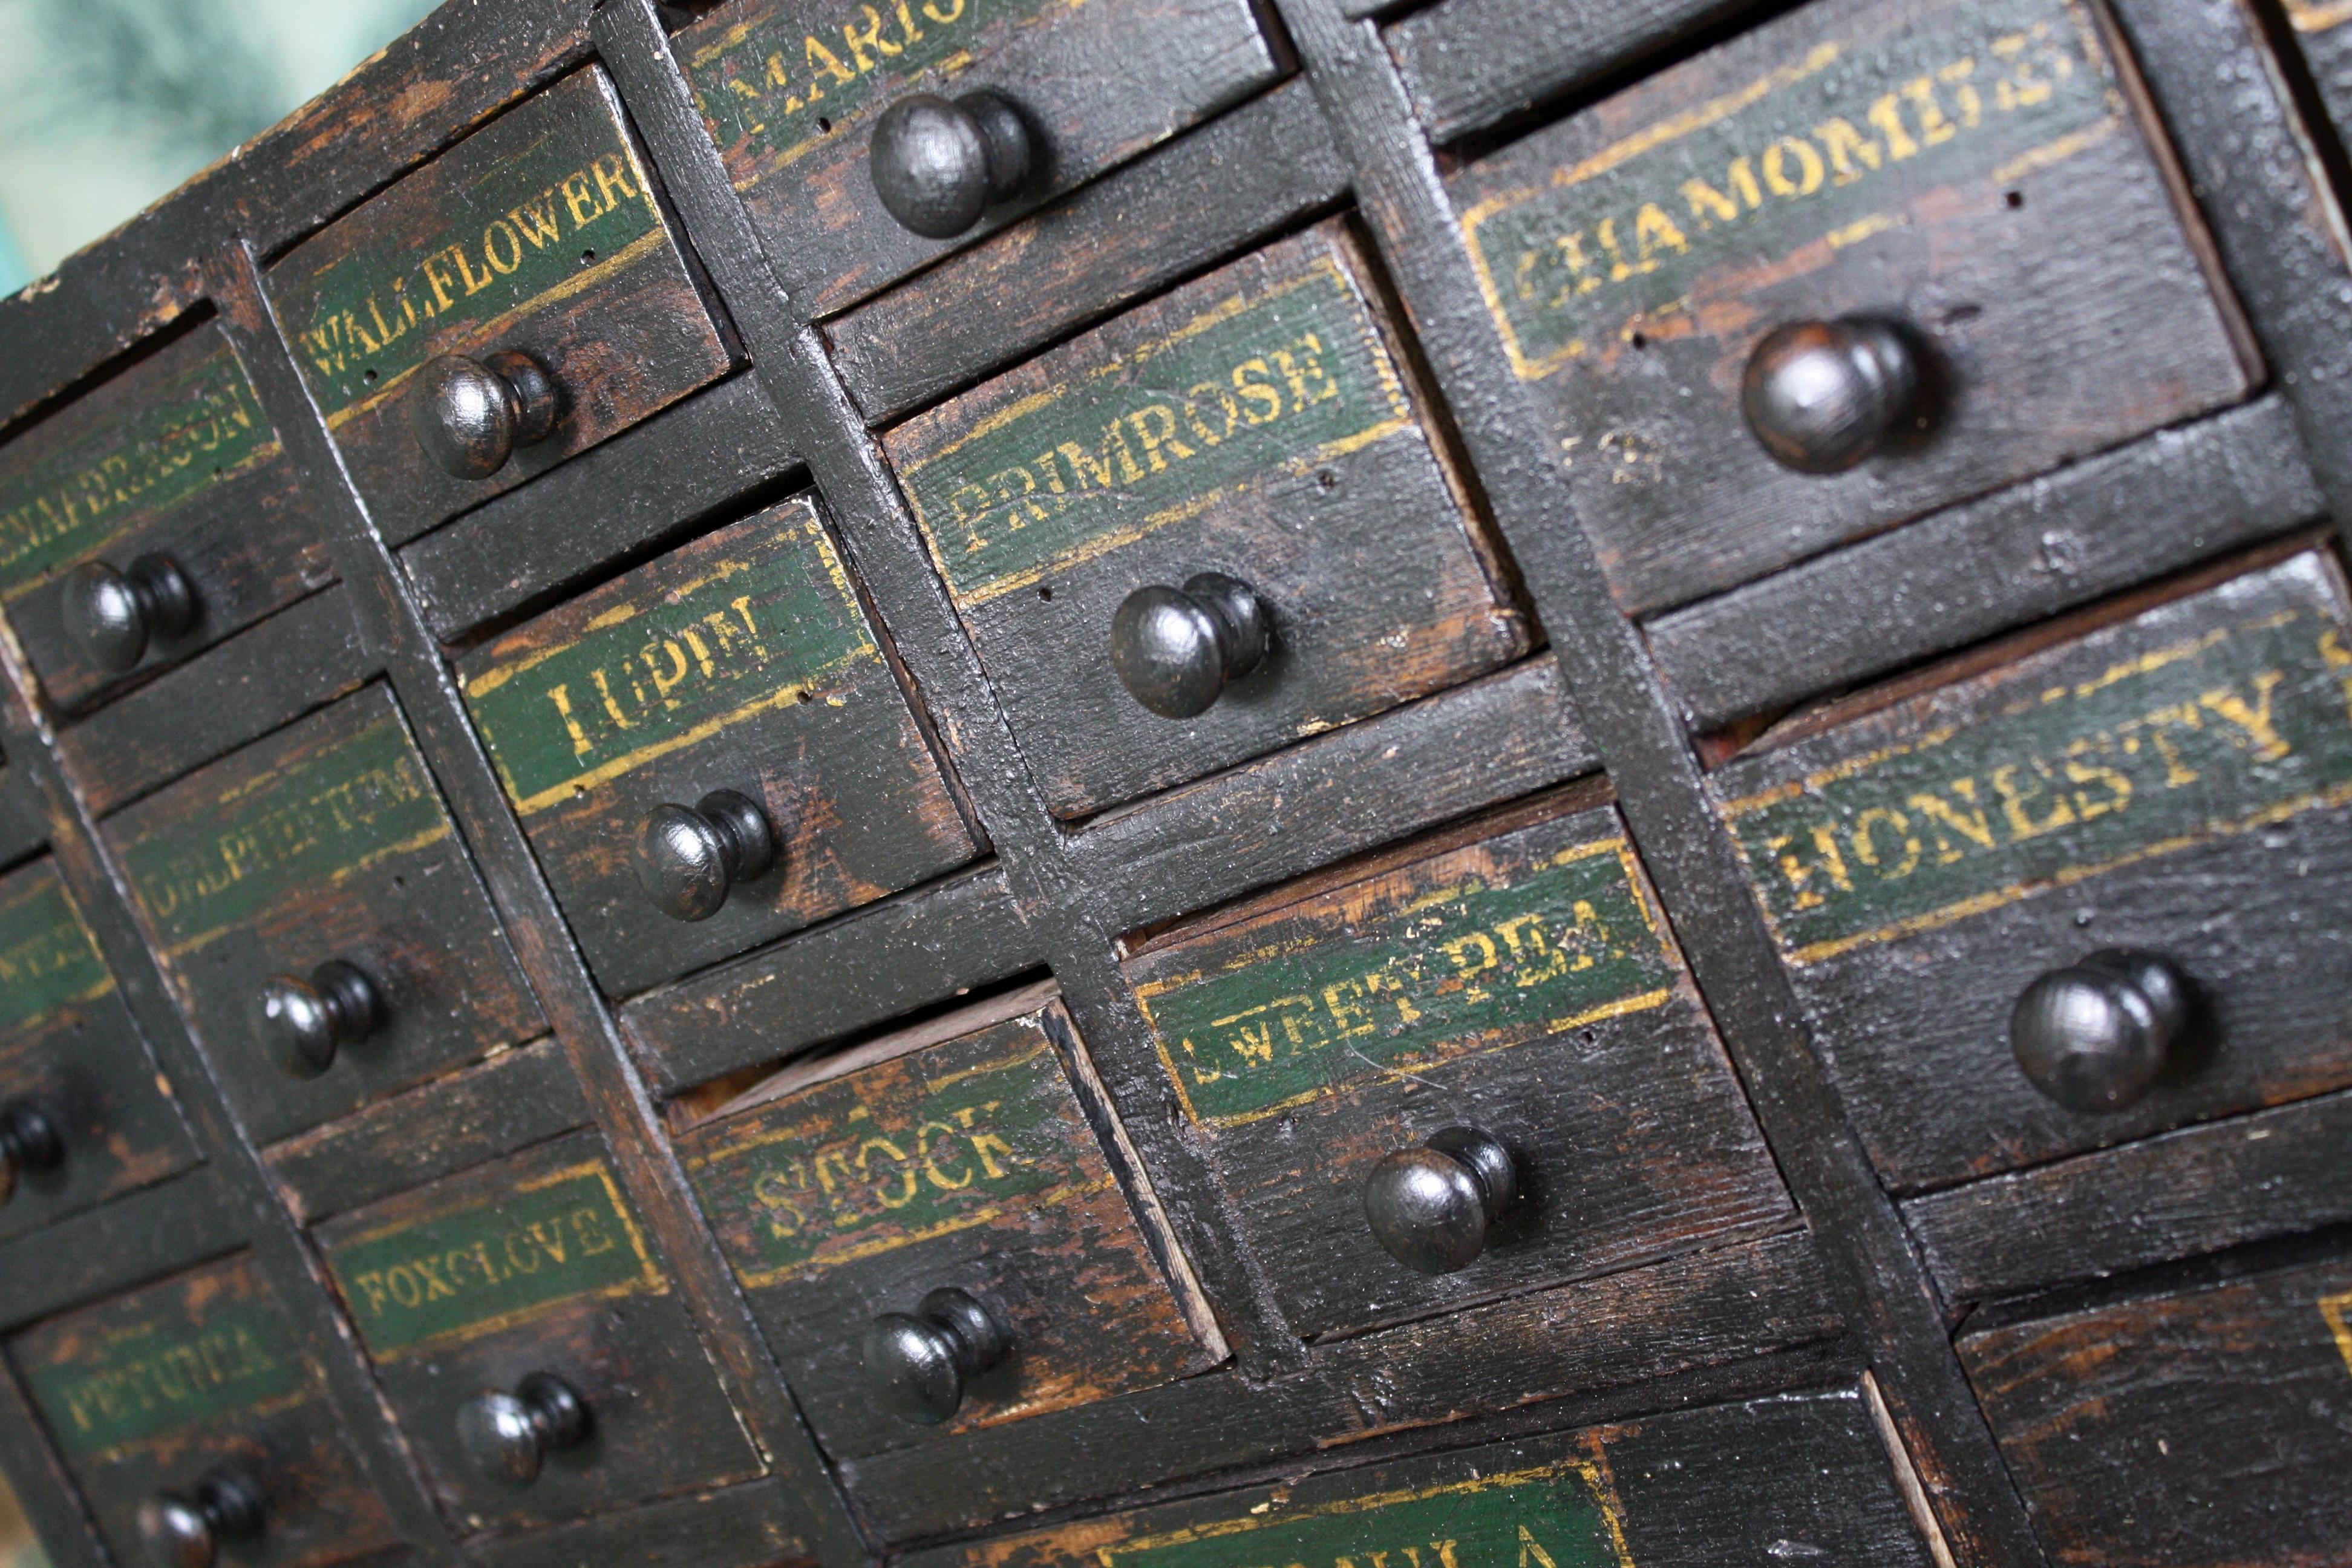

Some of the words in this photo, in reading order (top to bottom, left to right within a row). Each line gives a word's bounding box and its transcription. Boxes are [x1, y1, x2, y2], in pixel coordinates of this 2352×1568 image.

[299, 150, 638, 377] WALLFLOWER
[949, 332, 1338, 555] PRIMROSE
[1765, 668, 2292, 911] HONESTY
[753, 1100, 1037, 1240] STOCK
